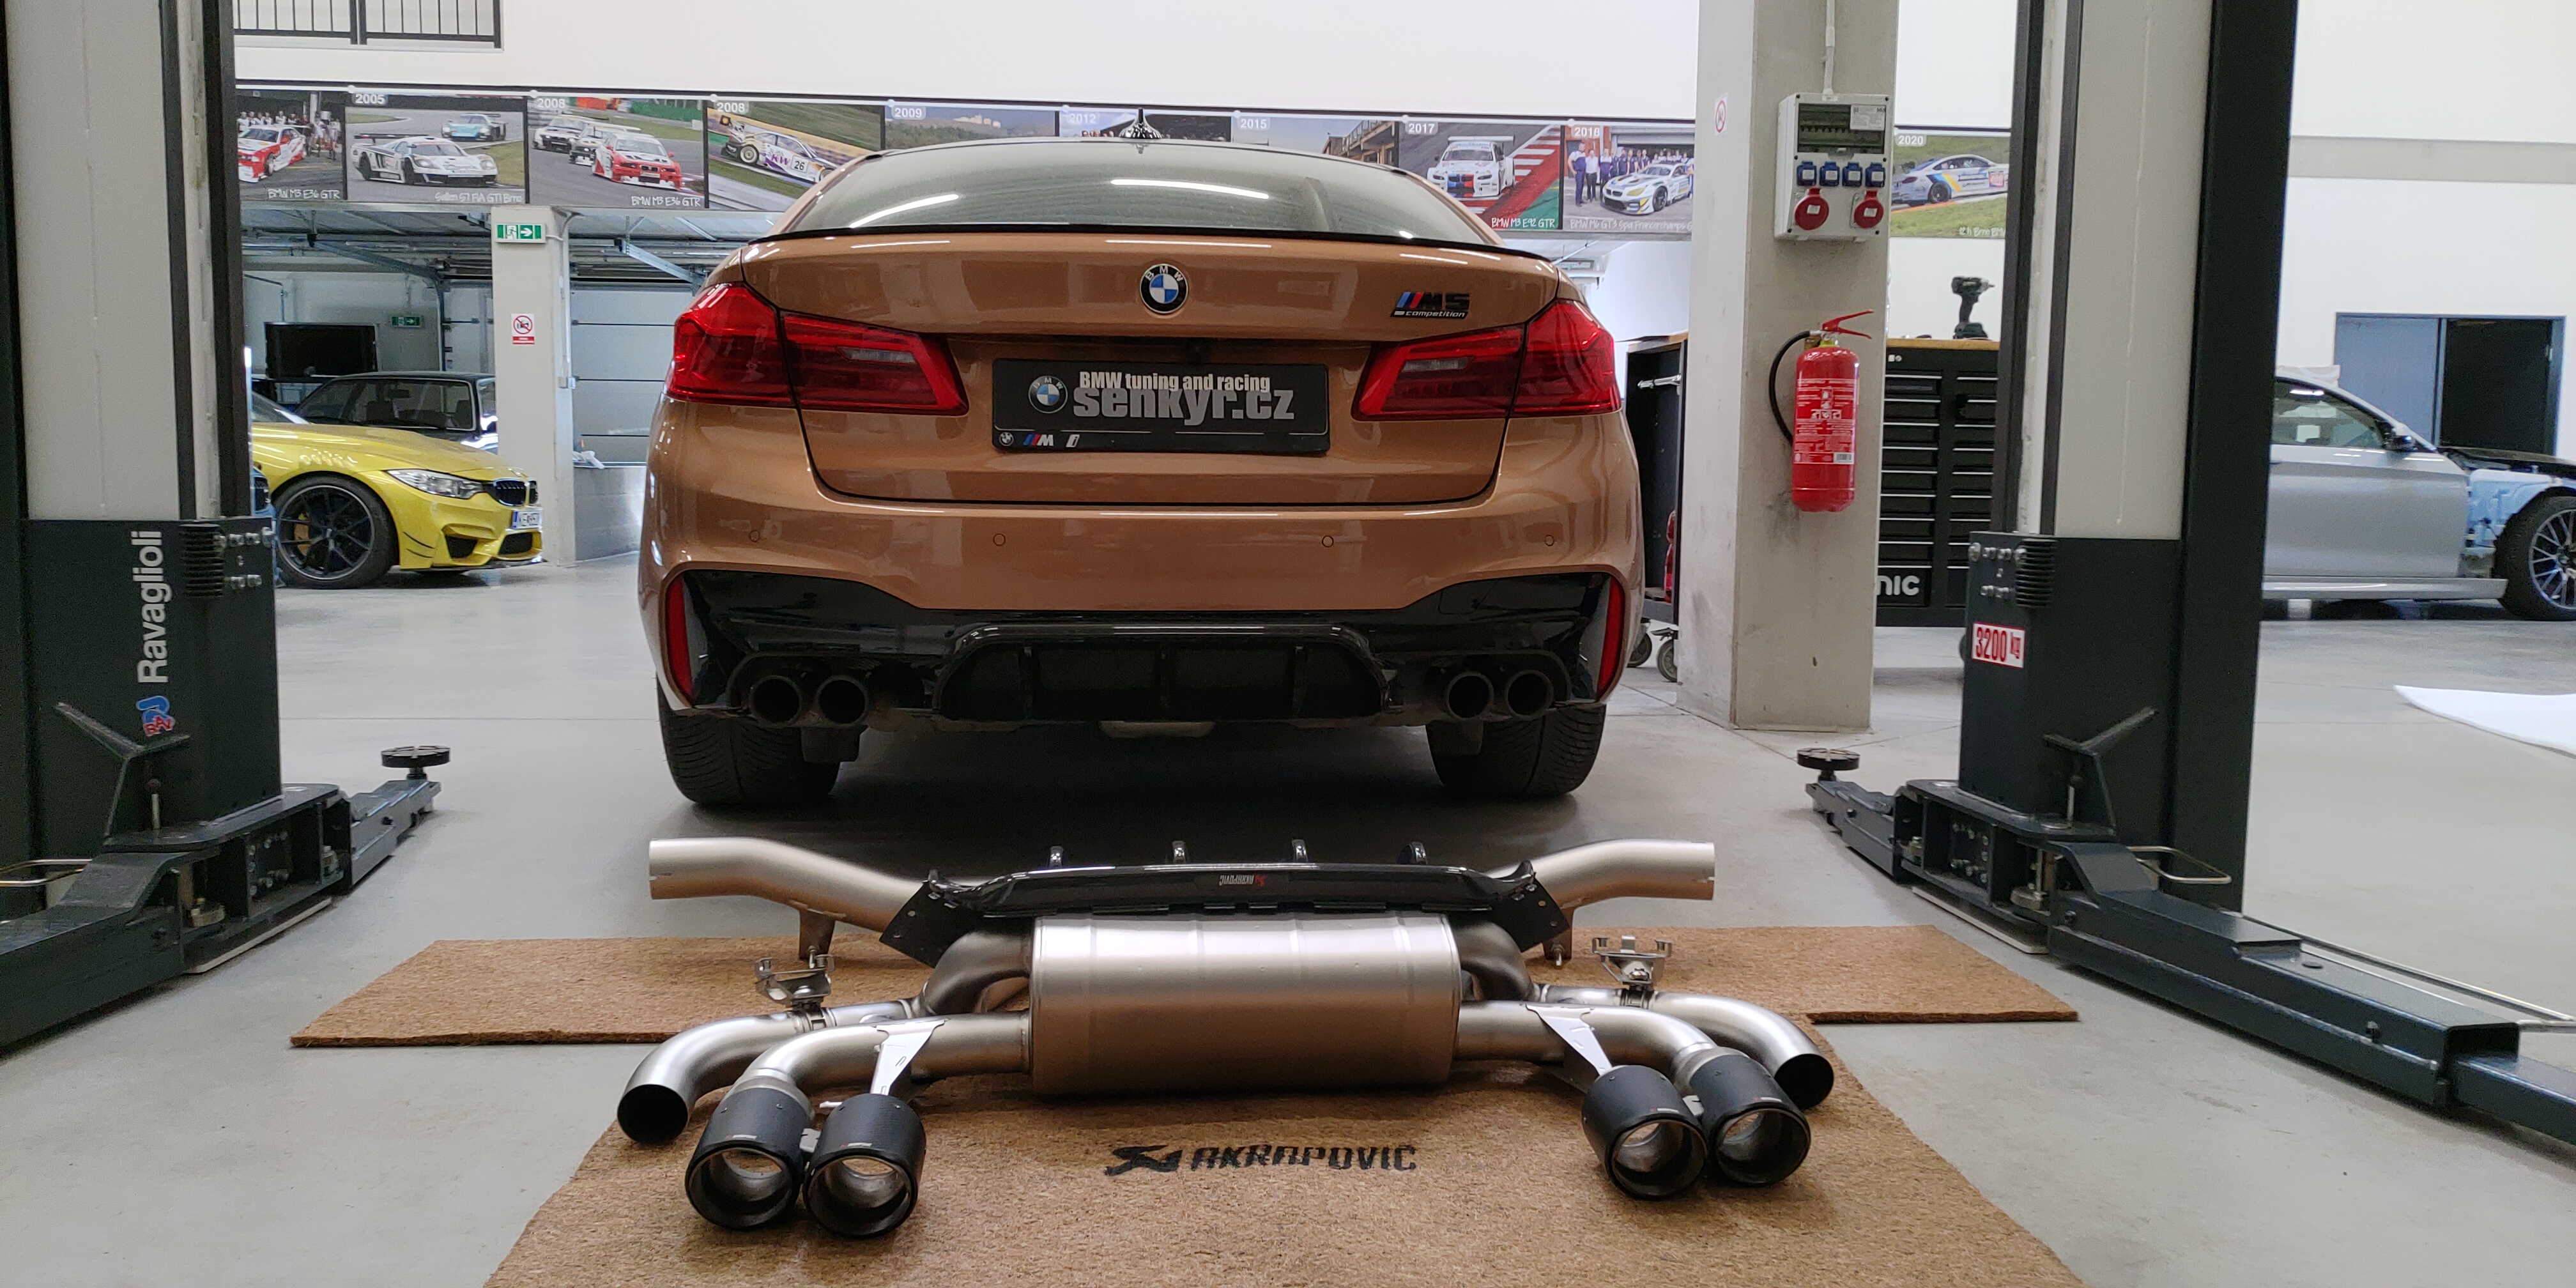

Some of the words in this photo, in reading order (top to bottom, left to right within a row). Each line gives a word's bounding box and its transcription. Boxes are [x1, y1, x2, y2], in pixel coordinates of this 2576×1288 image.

[355, 93, 386, 105] 2005
[537, 98, 565, 109] 2008
[716, 102, 746, 112] 2008
[894, 107, 923, 118] 2009
[1070, 112, 1097, 124] 2012
[1240, 118, 1268, 129] 2015
[1409, 123, 1436, 135] 2017
[1898, 135, 1924, 145] 2020
[794, 160, 805, 171] 26
[631, 195, 650, 206] BMW
[665, 197, 681, 206] E36
[682, 197, 702, 207] GTR
[1491, 217, 1509, 228] BMW
[1510, 218, 1521, 227] M3
[1522, 218, 1537, 228] E92
[1538, 218, 1555, 228] GTR
[1145, 265, 1183, 282] BMW
[1415, 292, 1470, 310] M5
[1079, 371, 1123, 389] BMW
[1125, 372, 1179, 392] tuning
[1182, 373, 1213, 390] and
[1217, 374, 1270, 393] racing
[1073, 387, 1294, 426] senkyr.cz
[130, 531, 172, 683] Ravaglioli
[1976, 627, 2007, 662] 3200
